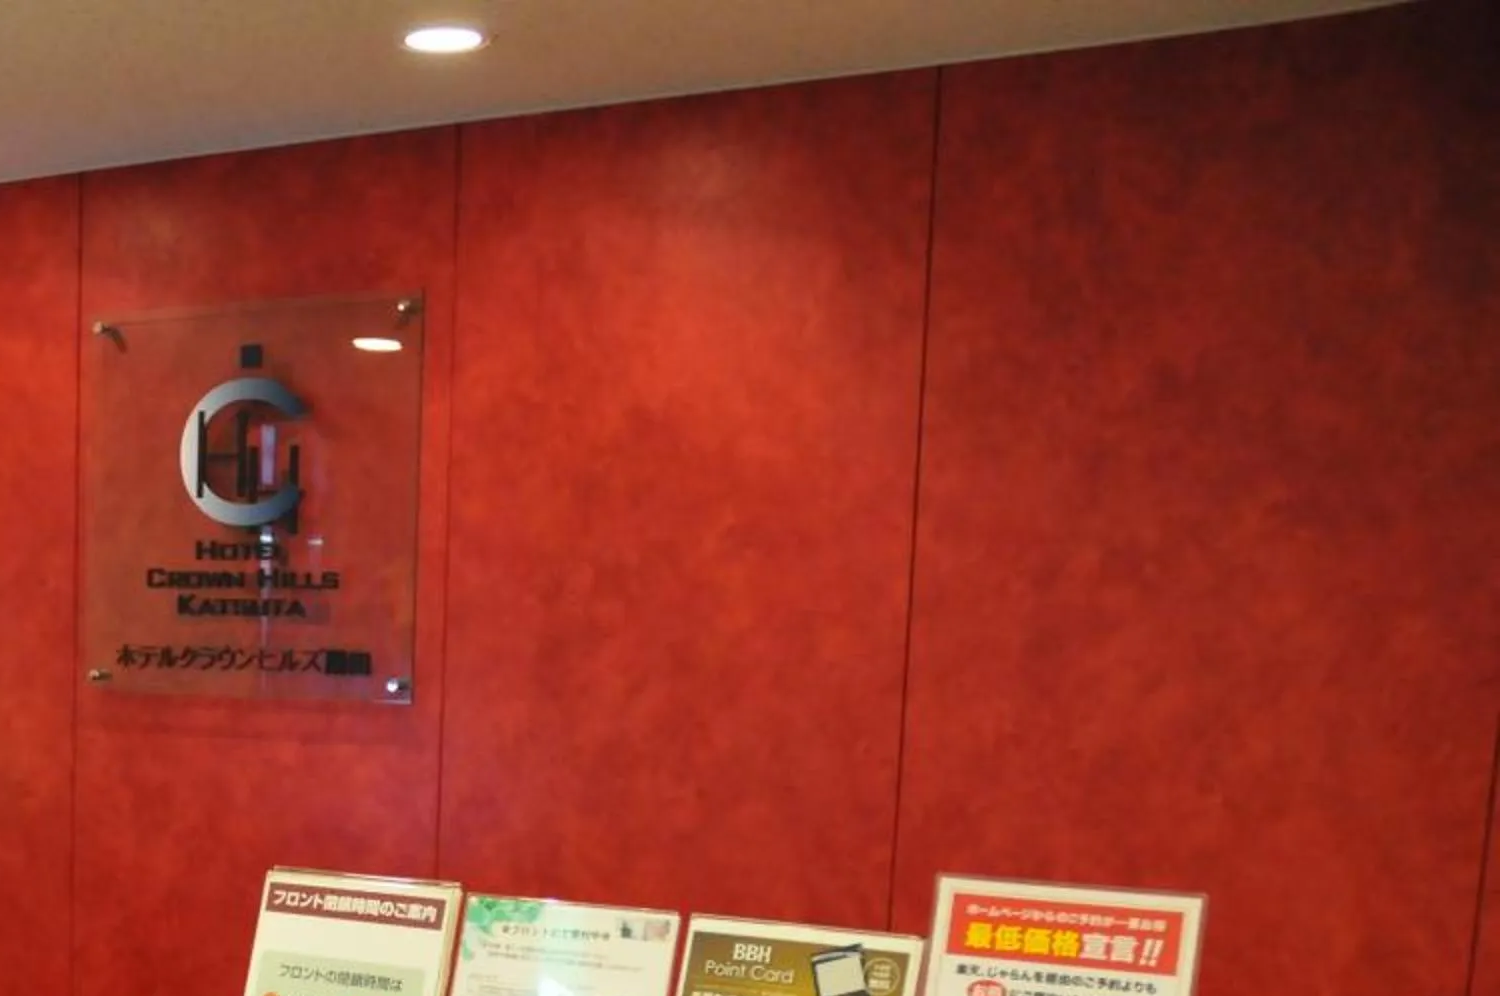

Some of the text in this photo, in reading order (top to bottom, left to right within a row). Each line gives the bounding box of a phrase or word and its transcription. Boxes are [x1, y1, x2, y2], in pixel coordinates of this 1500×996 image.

[146, 568, 339, 590] CROWN HILLS
[732, 943, 772, 964] BBH
[704, 958, 794, 984] Point Card
